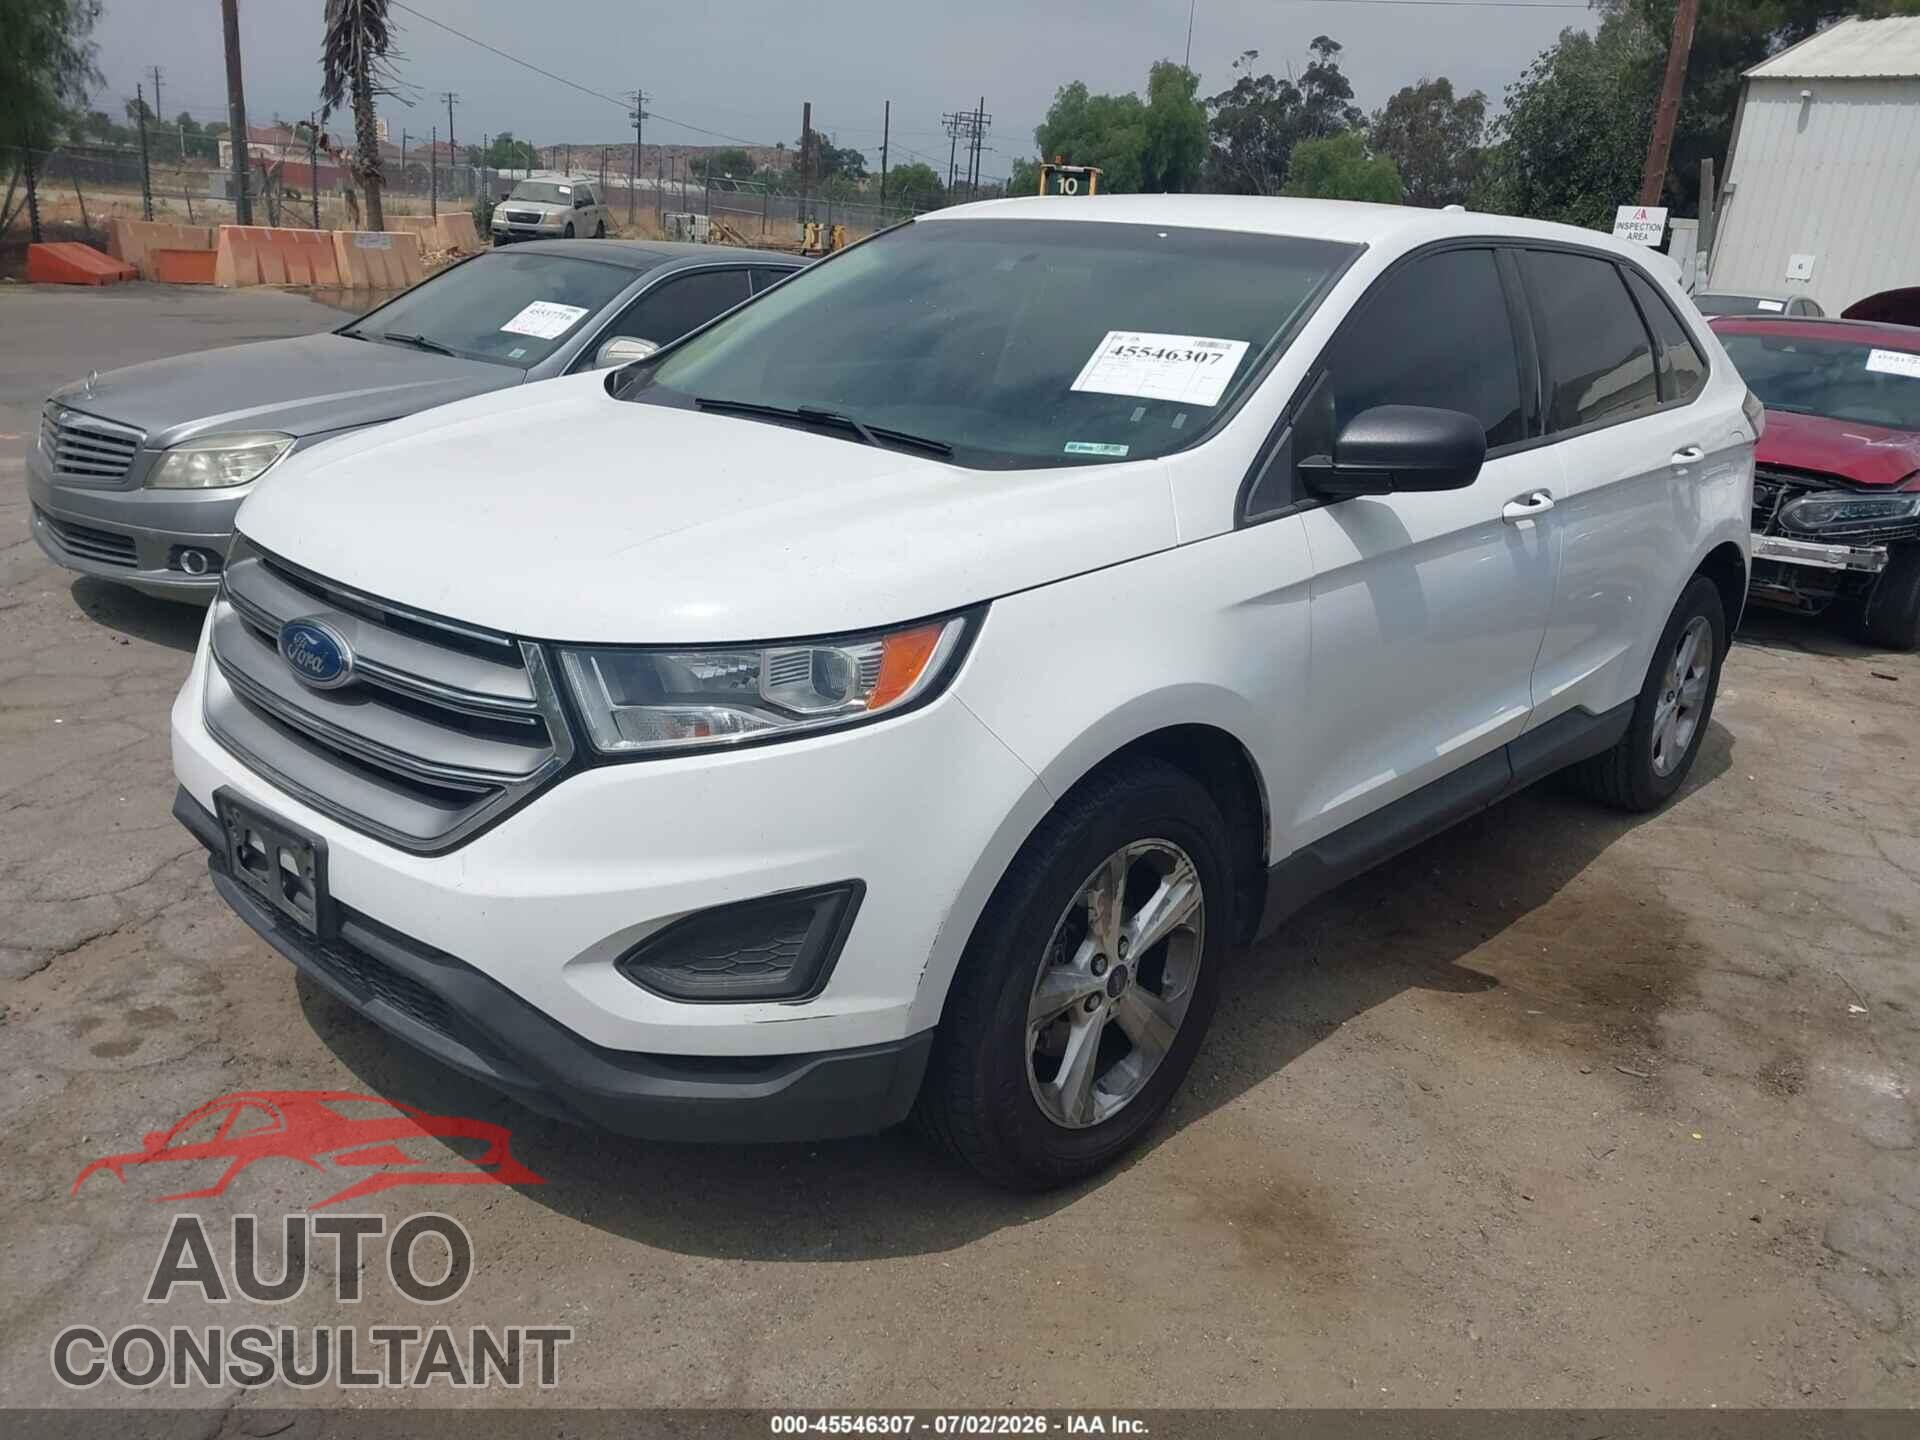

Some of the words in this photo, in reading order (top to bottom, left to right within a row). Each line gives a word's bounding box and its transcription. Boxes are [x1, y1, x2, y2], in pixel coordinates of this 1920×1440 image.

[1057, 177, 1078, 195] 10
[1616, 222, 1663, 232] INSPECTION
[1627, 232, 1648, 241] AREA
[1110, 345, 1224, 366] 45546307
[287, 631, 327, 673] Ford
